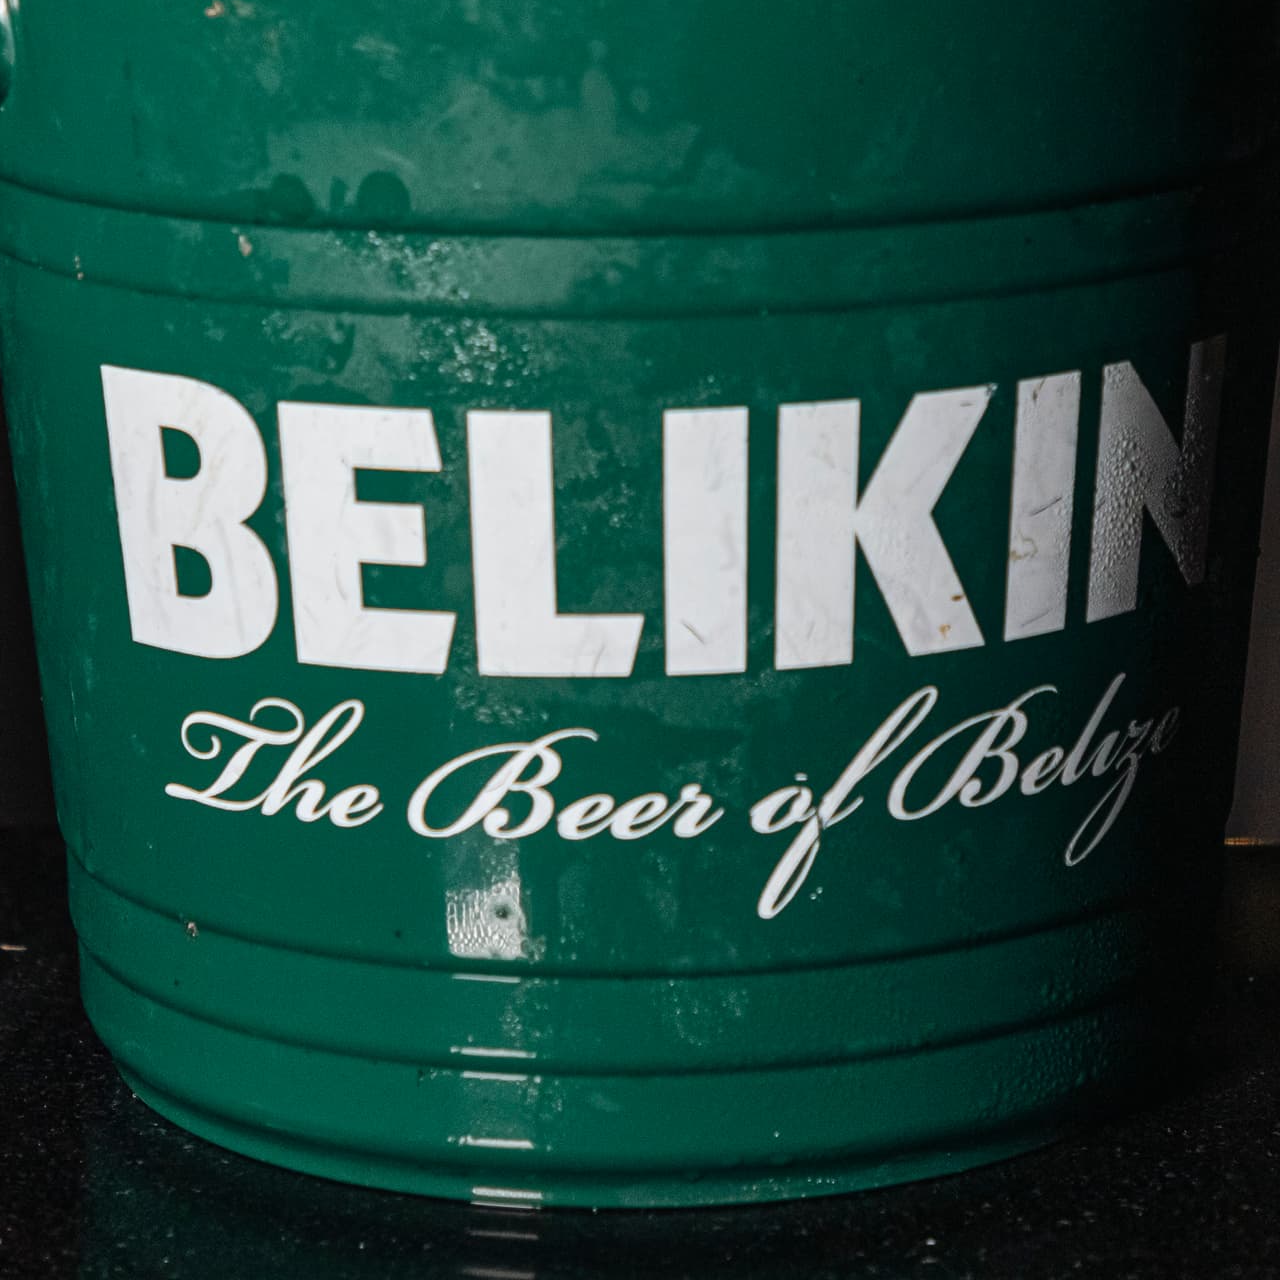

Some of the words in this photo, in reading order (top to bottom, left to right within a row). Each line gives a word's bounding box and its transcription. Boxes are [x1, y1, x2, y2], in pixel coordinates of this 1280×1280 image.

[100, 332, 1230, 677] BELIKIN
[165, 696, 384, 829] The
[407, 726, 724, 841] Beer
[749, 683, 938, 921] of
